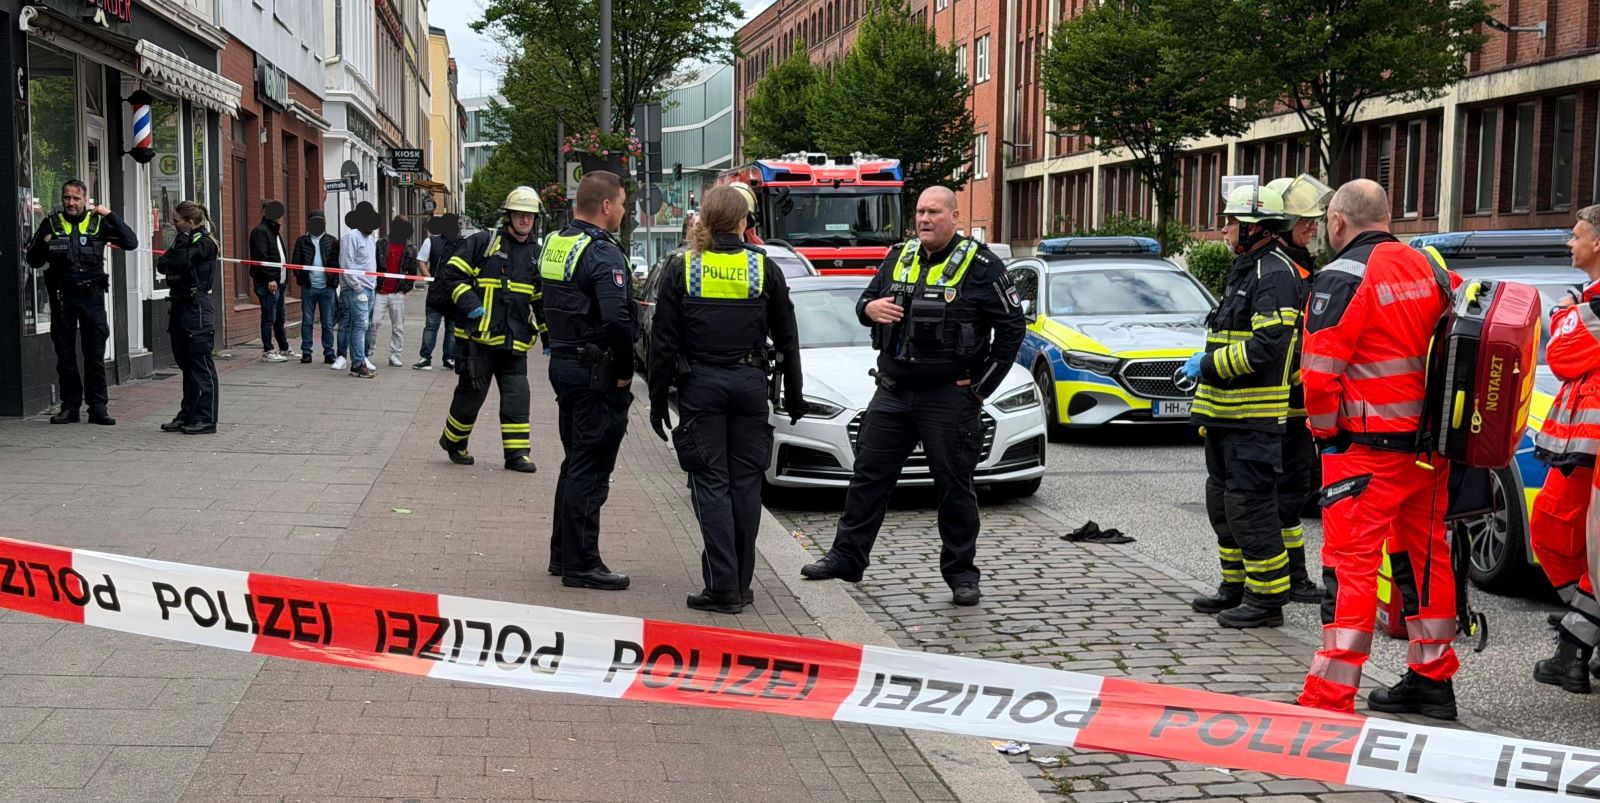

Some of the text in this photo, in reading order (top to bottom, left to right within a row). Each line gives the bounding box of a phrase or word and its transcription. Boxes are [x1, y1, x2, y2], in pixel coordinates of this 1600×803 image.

[394, 150, 421, 158] KIOSK
[544, 248, 567, 264] POLIZEI
[702, 265, 748, 281] POLIZEI
[1164, 402, 1180, 414] HH
[1485, 354, 1504, 412] NOTARZT
[152, 581, 333, 646] POLIZEI
[375, 609, 565, 675] POLIZEI
[605, 639, 820, 701] POLIZEI
[858, 673, 1102, 729] POLIZEI
[1148, 705, 1429, 775] POLIZEI
